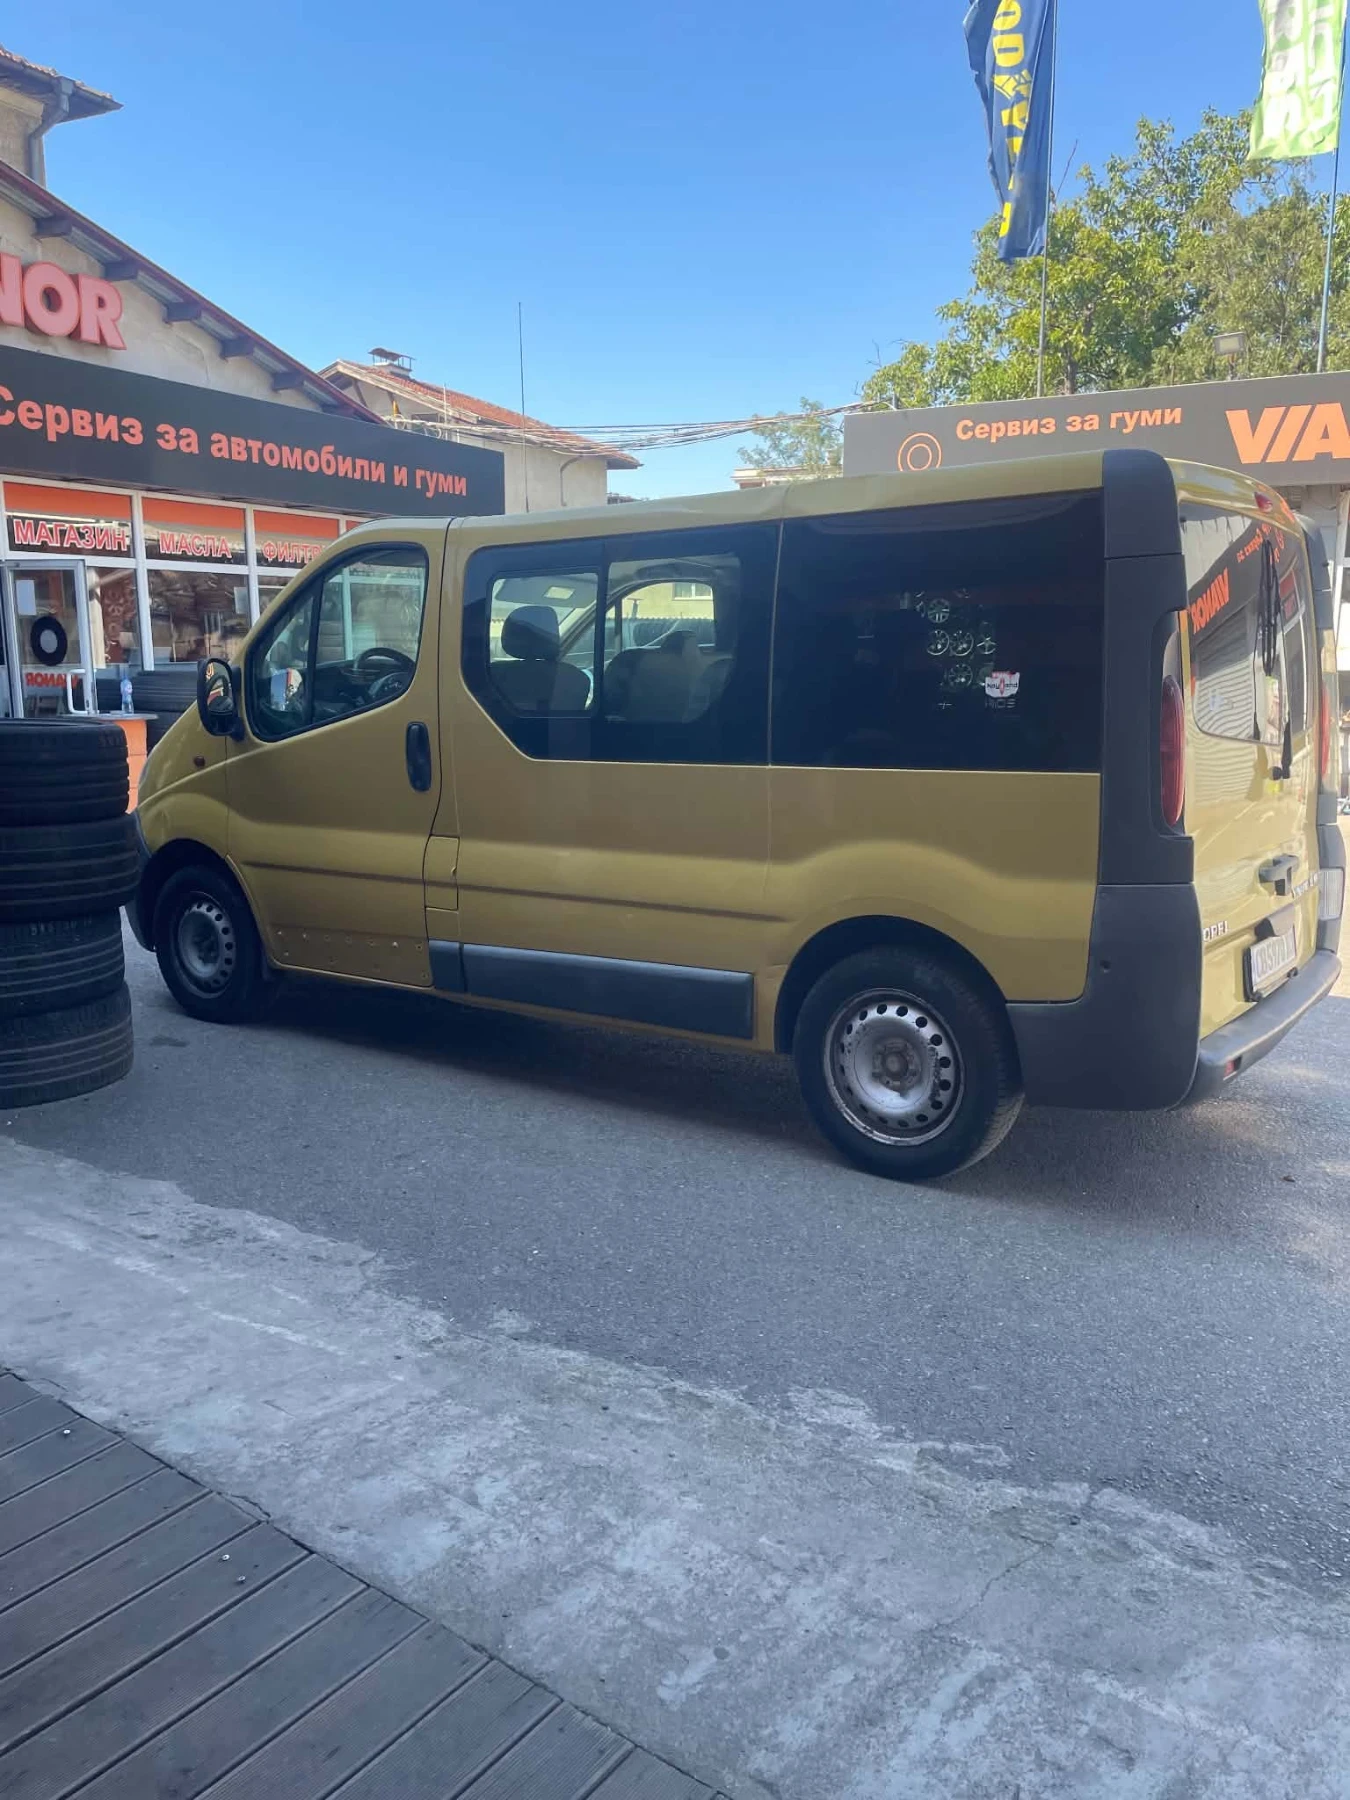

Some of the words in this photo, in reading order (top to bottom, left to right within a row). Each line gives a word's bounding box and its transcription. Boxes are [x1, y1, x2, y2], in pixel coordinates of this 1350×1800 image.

[956, 416, 1056, 443] Сервиз
[1066, 415, 1100, 433] за
[1109, 407, 1182, 435] гуми
[156, 423, 199, 454] за
[210, 432, 385, 483] автомобили
[393, 464, 408, 488] и
[415, 469, 468, 498] гуми
[13, 519, 128, 551] МАГАЗИН
[158, 531, 233, 559] МАСЛА
[262, 540, 325, 563] ФИЛТР
